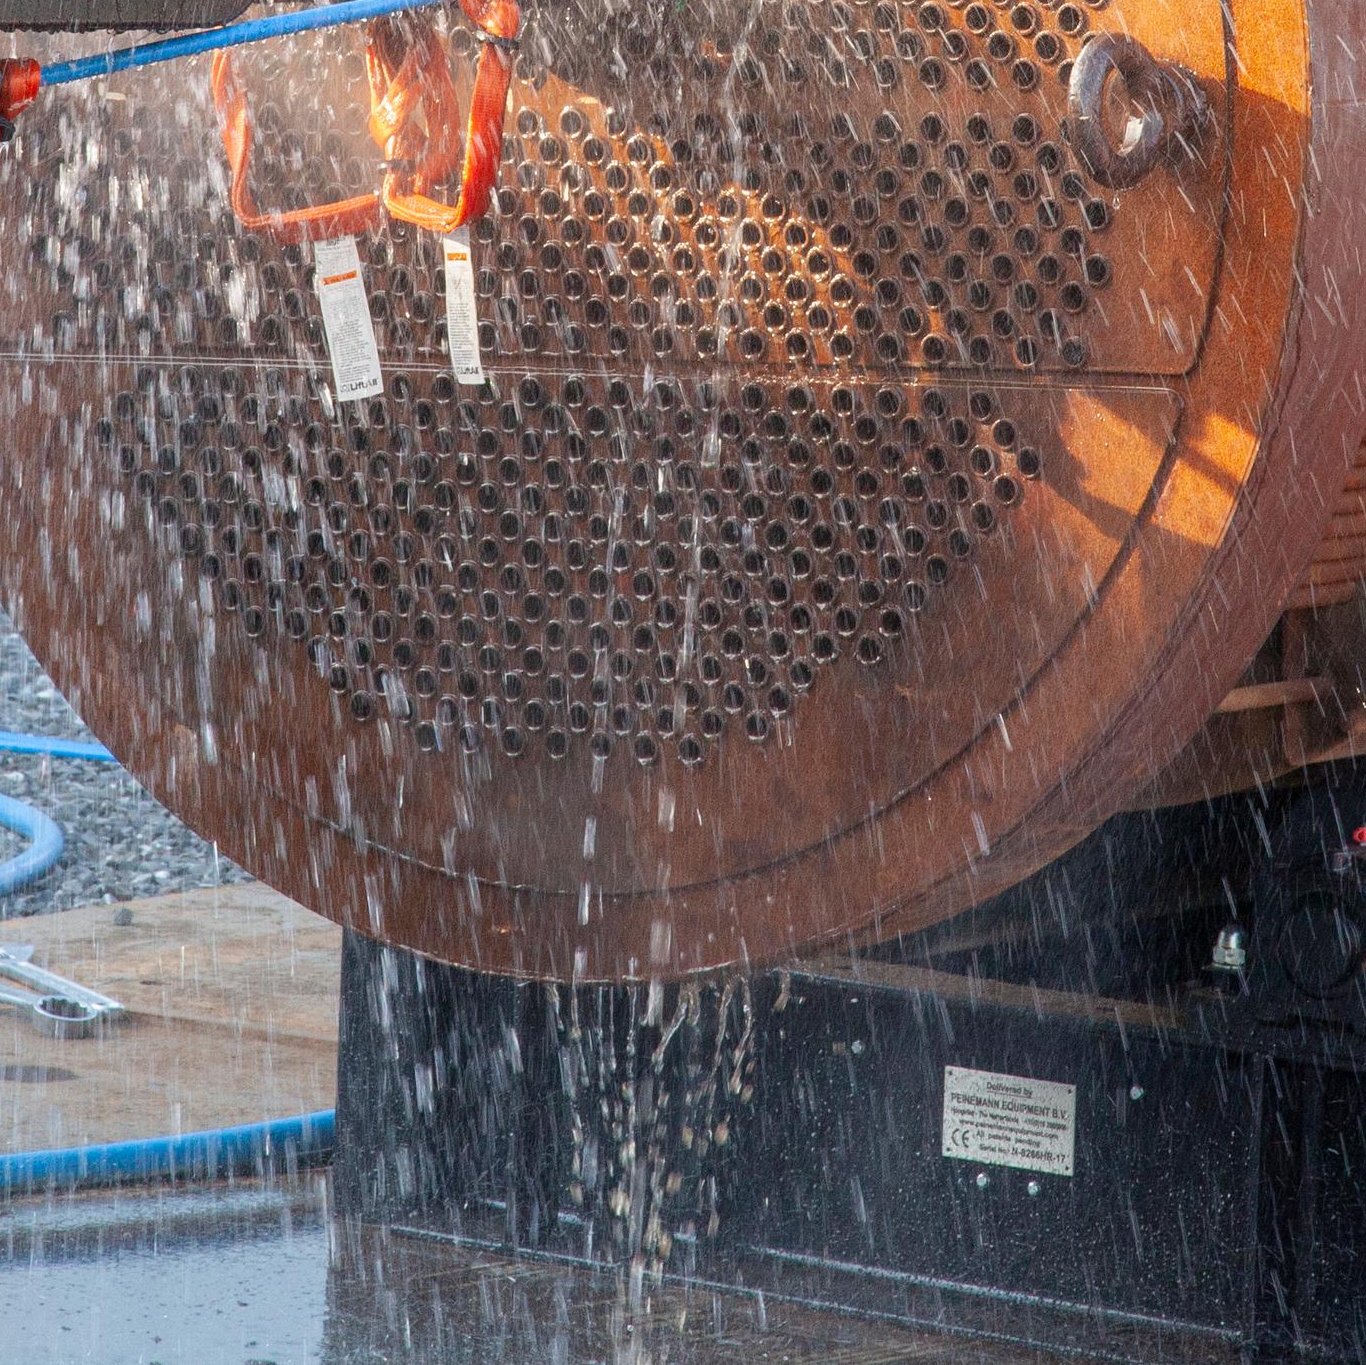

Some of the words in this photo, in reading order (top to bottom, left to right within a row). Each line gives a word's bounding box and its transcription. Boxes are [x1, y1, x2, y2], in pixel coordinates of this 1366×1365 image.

[987, 1082, 1022, 1094] Delivered
[1023, 1087, 1033, 1099] by
[951, 1092, 1000, 1109] PEINEMANN
[1002, 1100, 1050, 1117] EQUIPMENT
